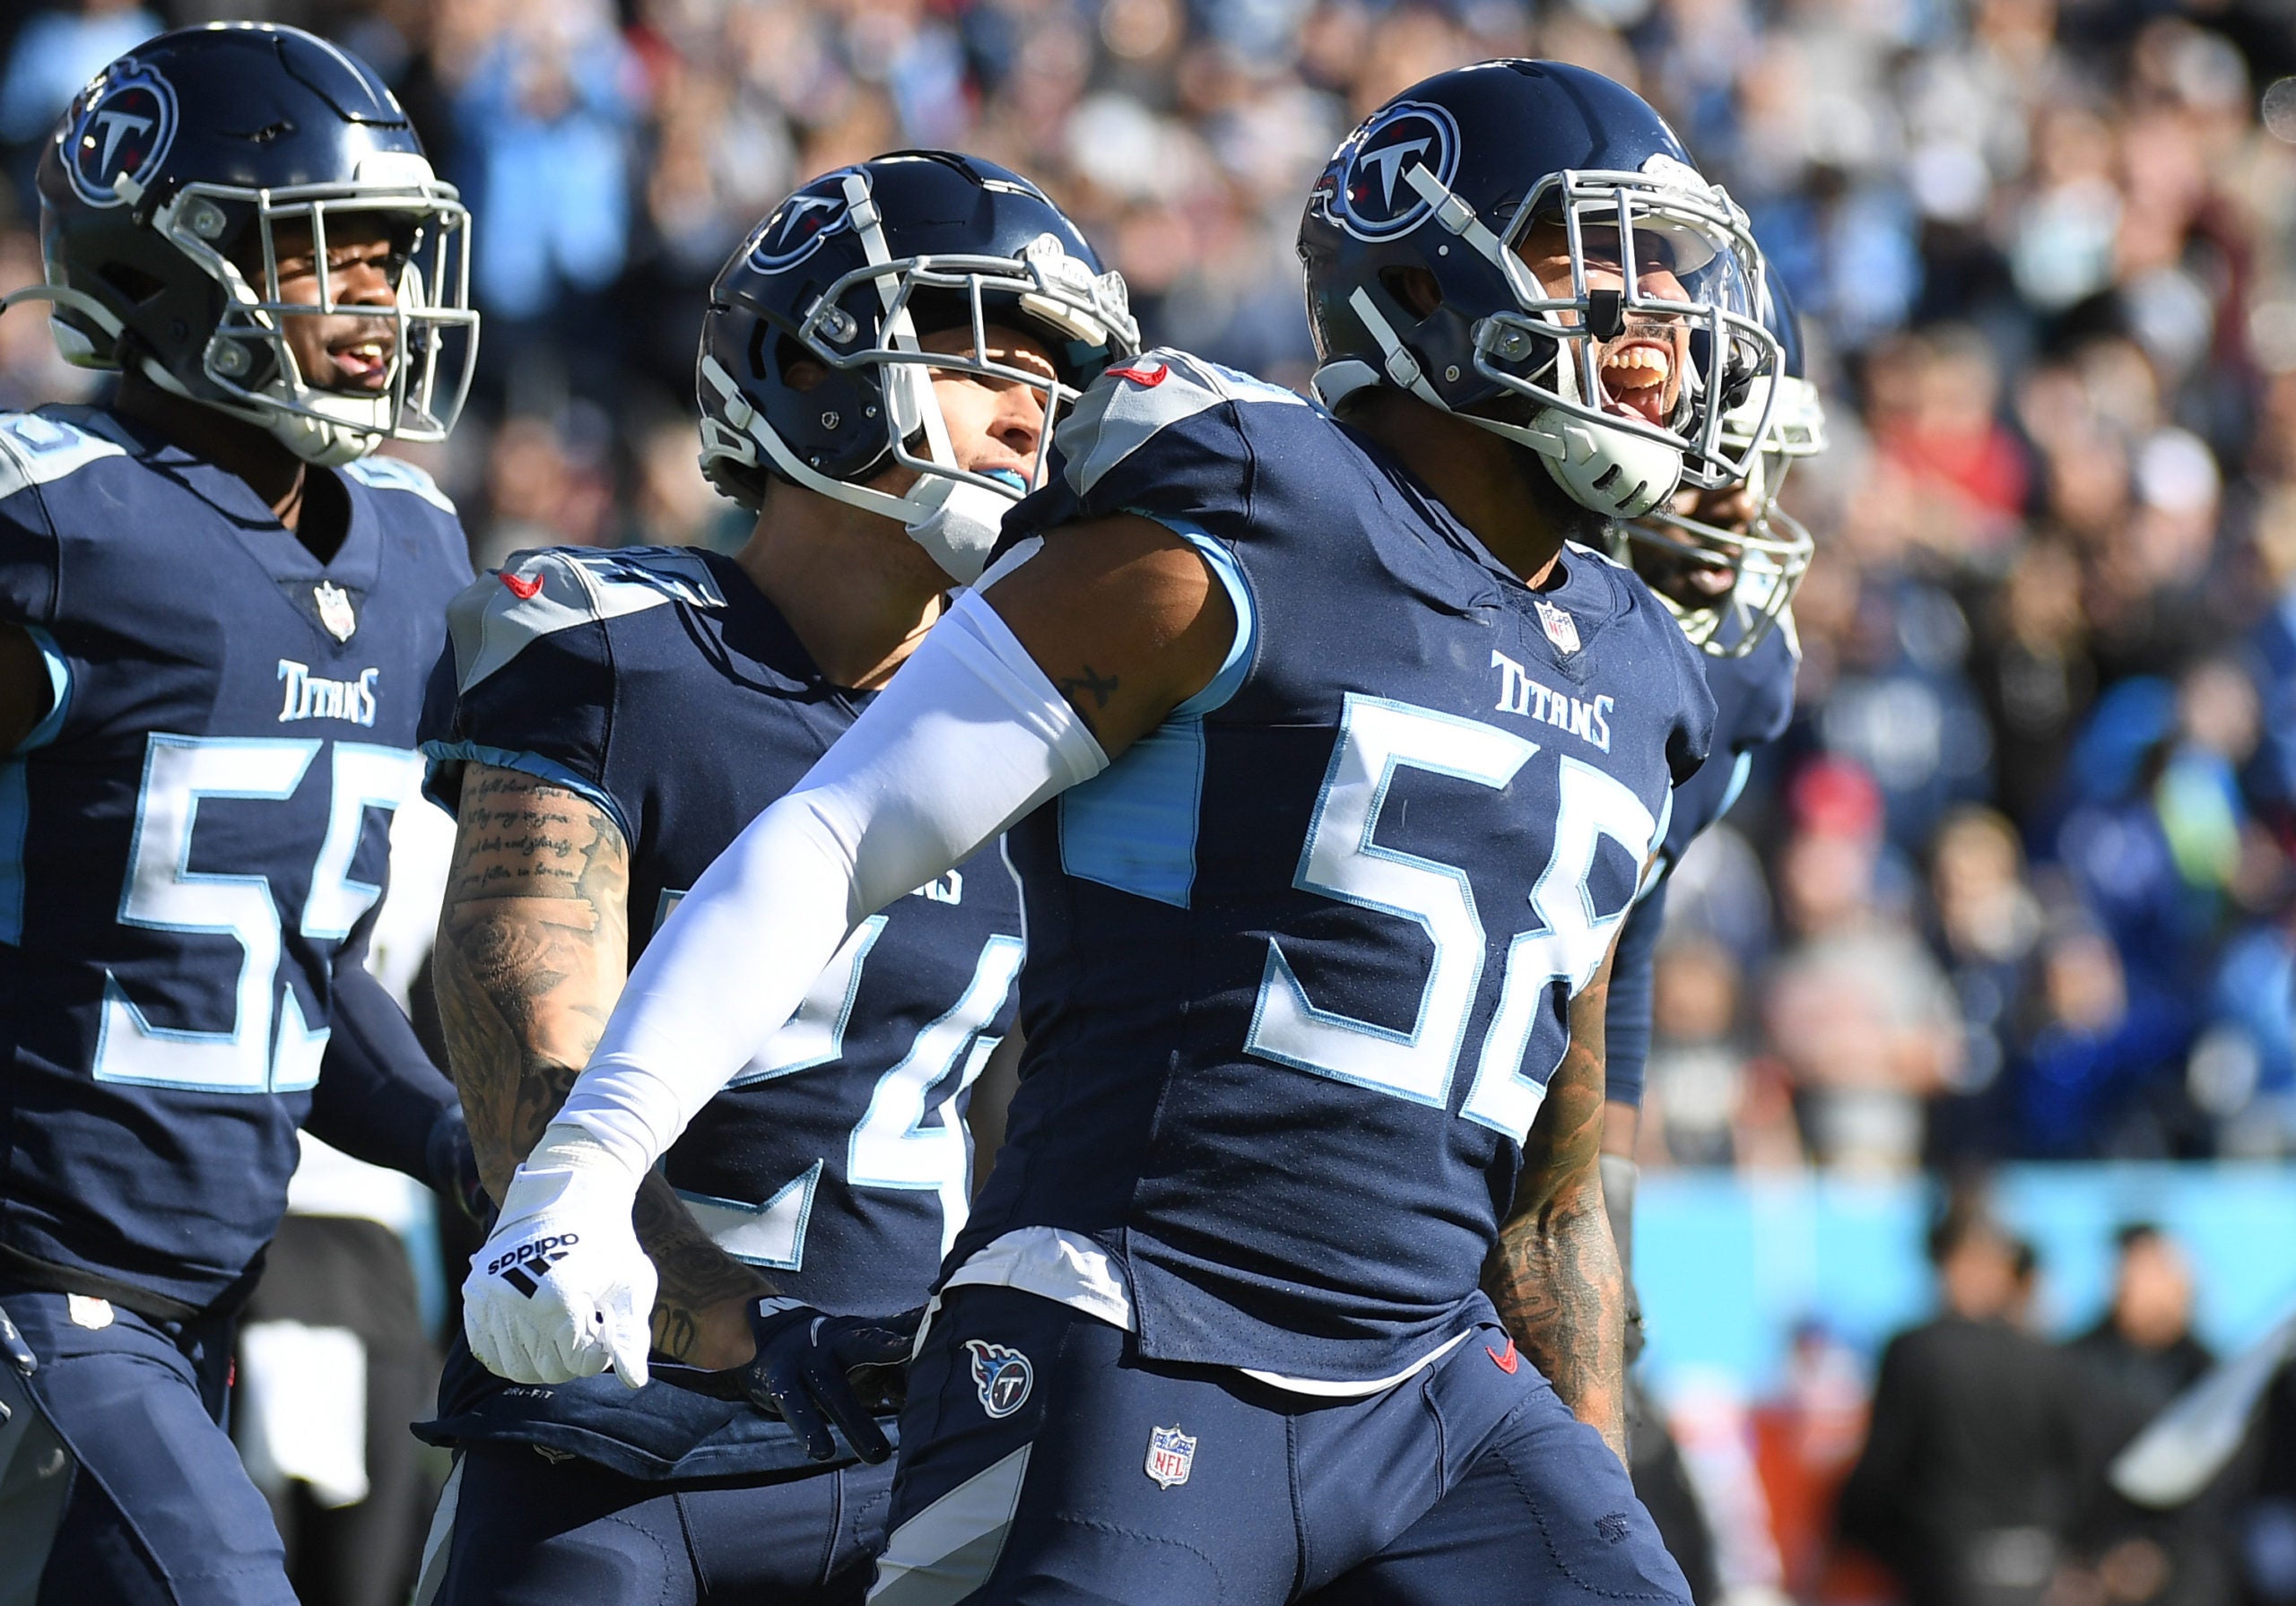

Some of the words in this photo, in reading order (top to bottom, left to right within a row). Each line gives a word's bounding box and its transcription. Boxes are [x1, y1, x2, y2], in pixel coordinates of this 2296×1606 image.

[95, 110, 153, 180] T
[1360, 136, 1432, 213] T
[277, 658, 379, 727] TITANS
[1491, 649, 1614, 754] TITANS
[1242, 691, 1656, 1149] 58
[488, 1233, 578, 1275] adidas
[997, 1376, 1024, 1407] T
[1154, 1451, 1183, 1477] NFL
